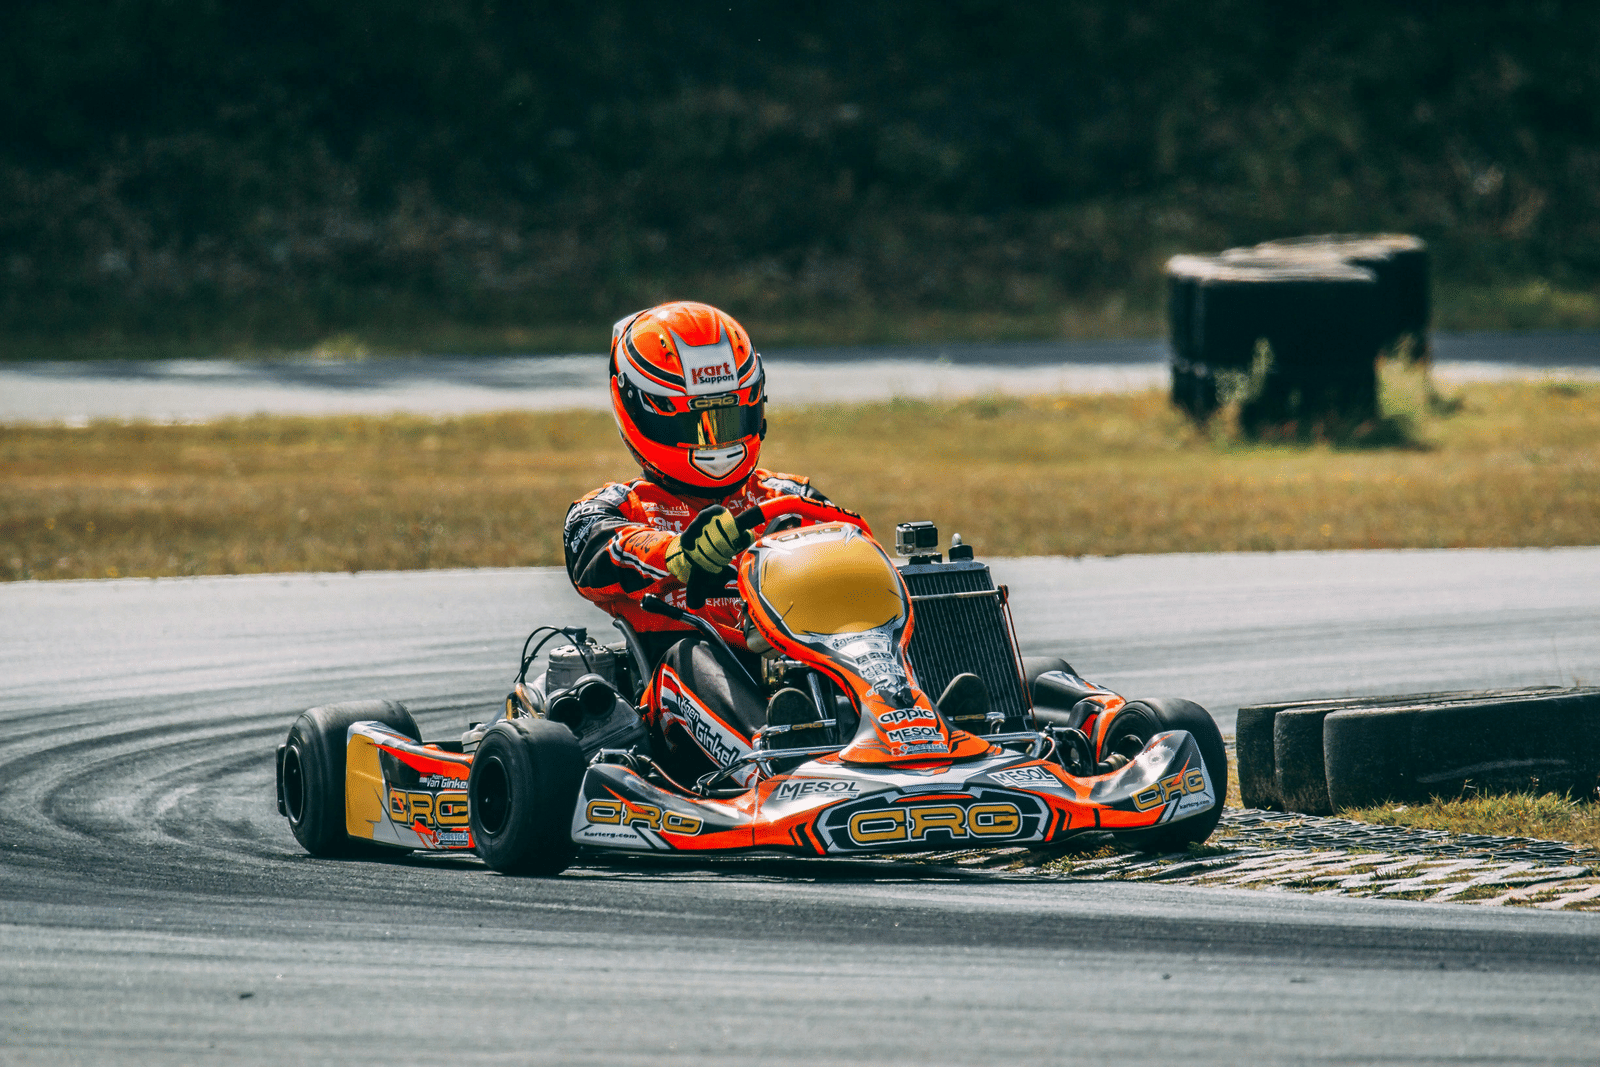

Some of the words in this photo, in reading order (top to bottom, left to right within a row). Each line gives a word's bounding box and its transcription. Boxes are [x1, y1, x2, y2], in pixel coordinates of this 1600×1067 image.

[691, 362, 731, 385] kart
[700, 374, 734, 385] Support
[695, 396, 734, 407] CRG
[880, 706, 934, 723] appic
[889, 727, 942, 742] MESOL
[426, 778, 440, 788] Van
[991, 767, 1055, 786] MESOL
[780, 781, 860, 801] MESOL
[1132, 769, 1205, 811] CRG
[389, 790, 469, 828] CRG
[585, 800, 702, 834] CRG
[849, 803, 1020, 844] CRG
